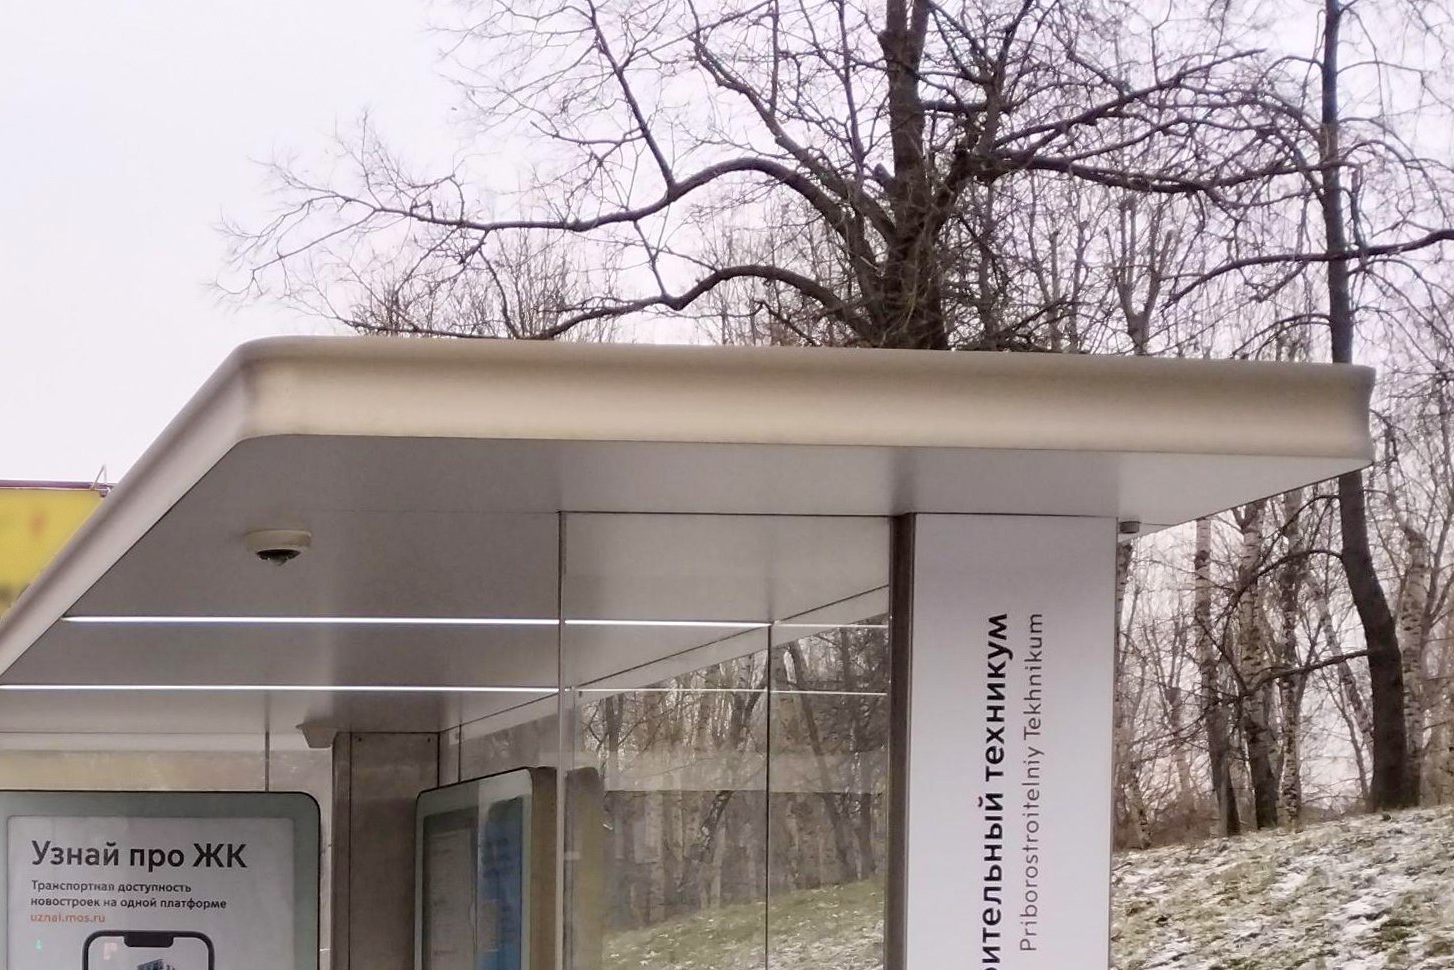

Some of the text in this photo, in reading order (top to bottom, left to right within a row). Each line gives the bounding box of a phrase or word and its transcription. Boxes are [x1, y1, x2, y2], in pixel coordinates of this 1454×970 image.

[984, 612, 1014, 783] техникум
[1019, 612, 1045, 952] Priborostroitelniy Tekhnikum
[31, 840, 248, 872] Узнай про ЖК
[31, 880, 192, 894] Транспортная доступность
[30, 897, 227, 911] новостроек на одной платформе
[30, 912, 106, 924] uznai.mos.ru
